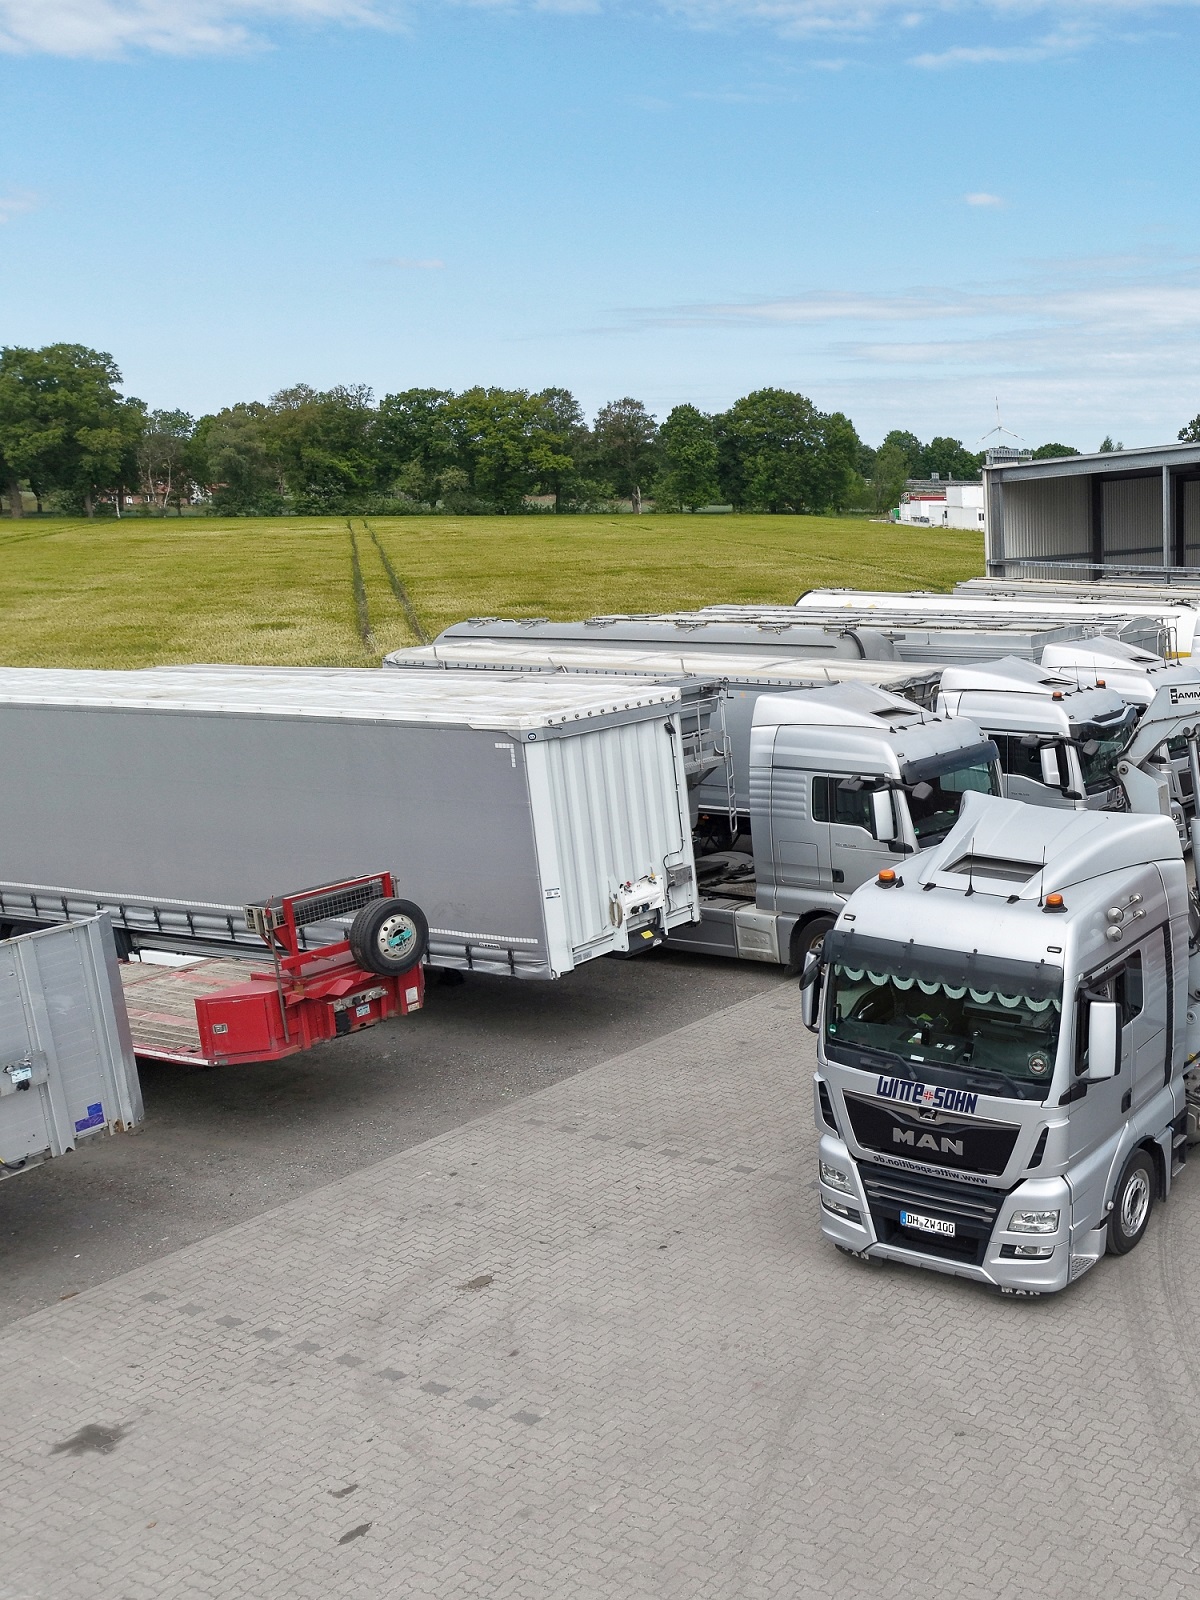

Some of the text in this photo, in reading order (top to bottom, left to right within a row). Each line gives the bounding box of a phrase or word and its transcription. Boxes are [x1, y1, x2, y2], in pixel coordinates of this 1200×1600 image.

[876, 1076, 978, 1114] WITTE SOHN
[892, 1127, 964, 1156] MAN
[907, 1215, 919, 1225] DH
[924, 1218, 935, 1229] ZW
